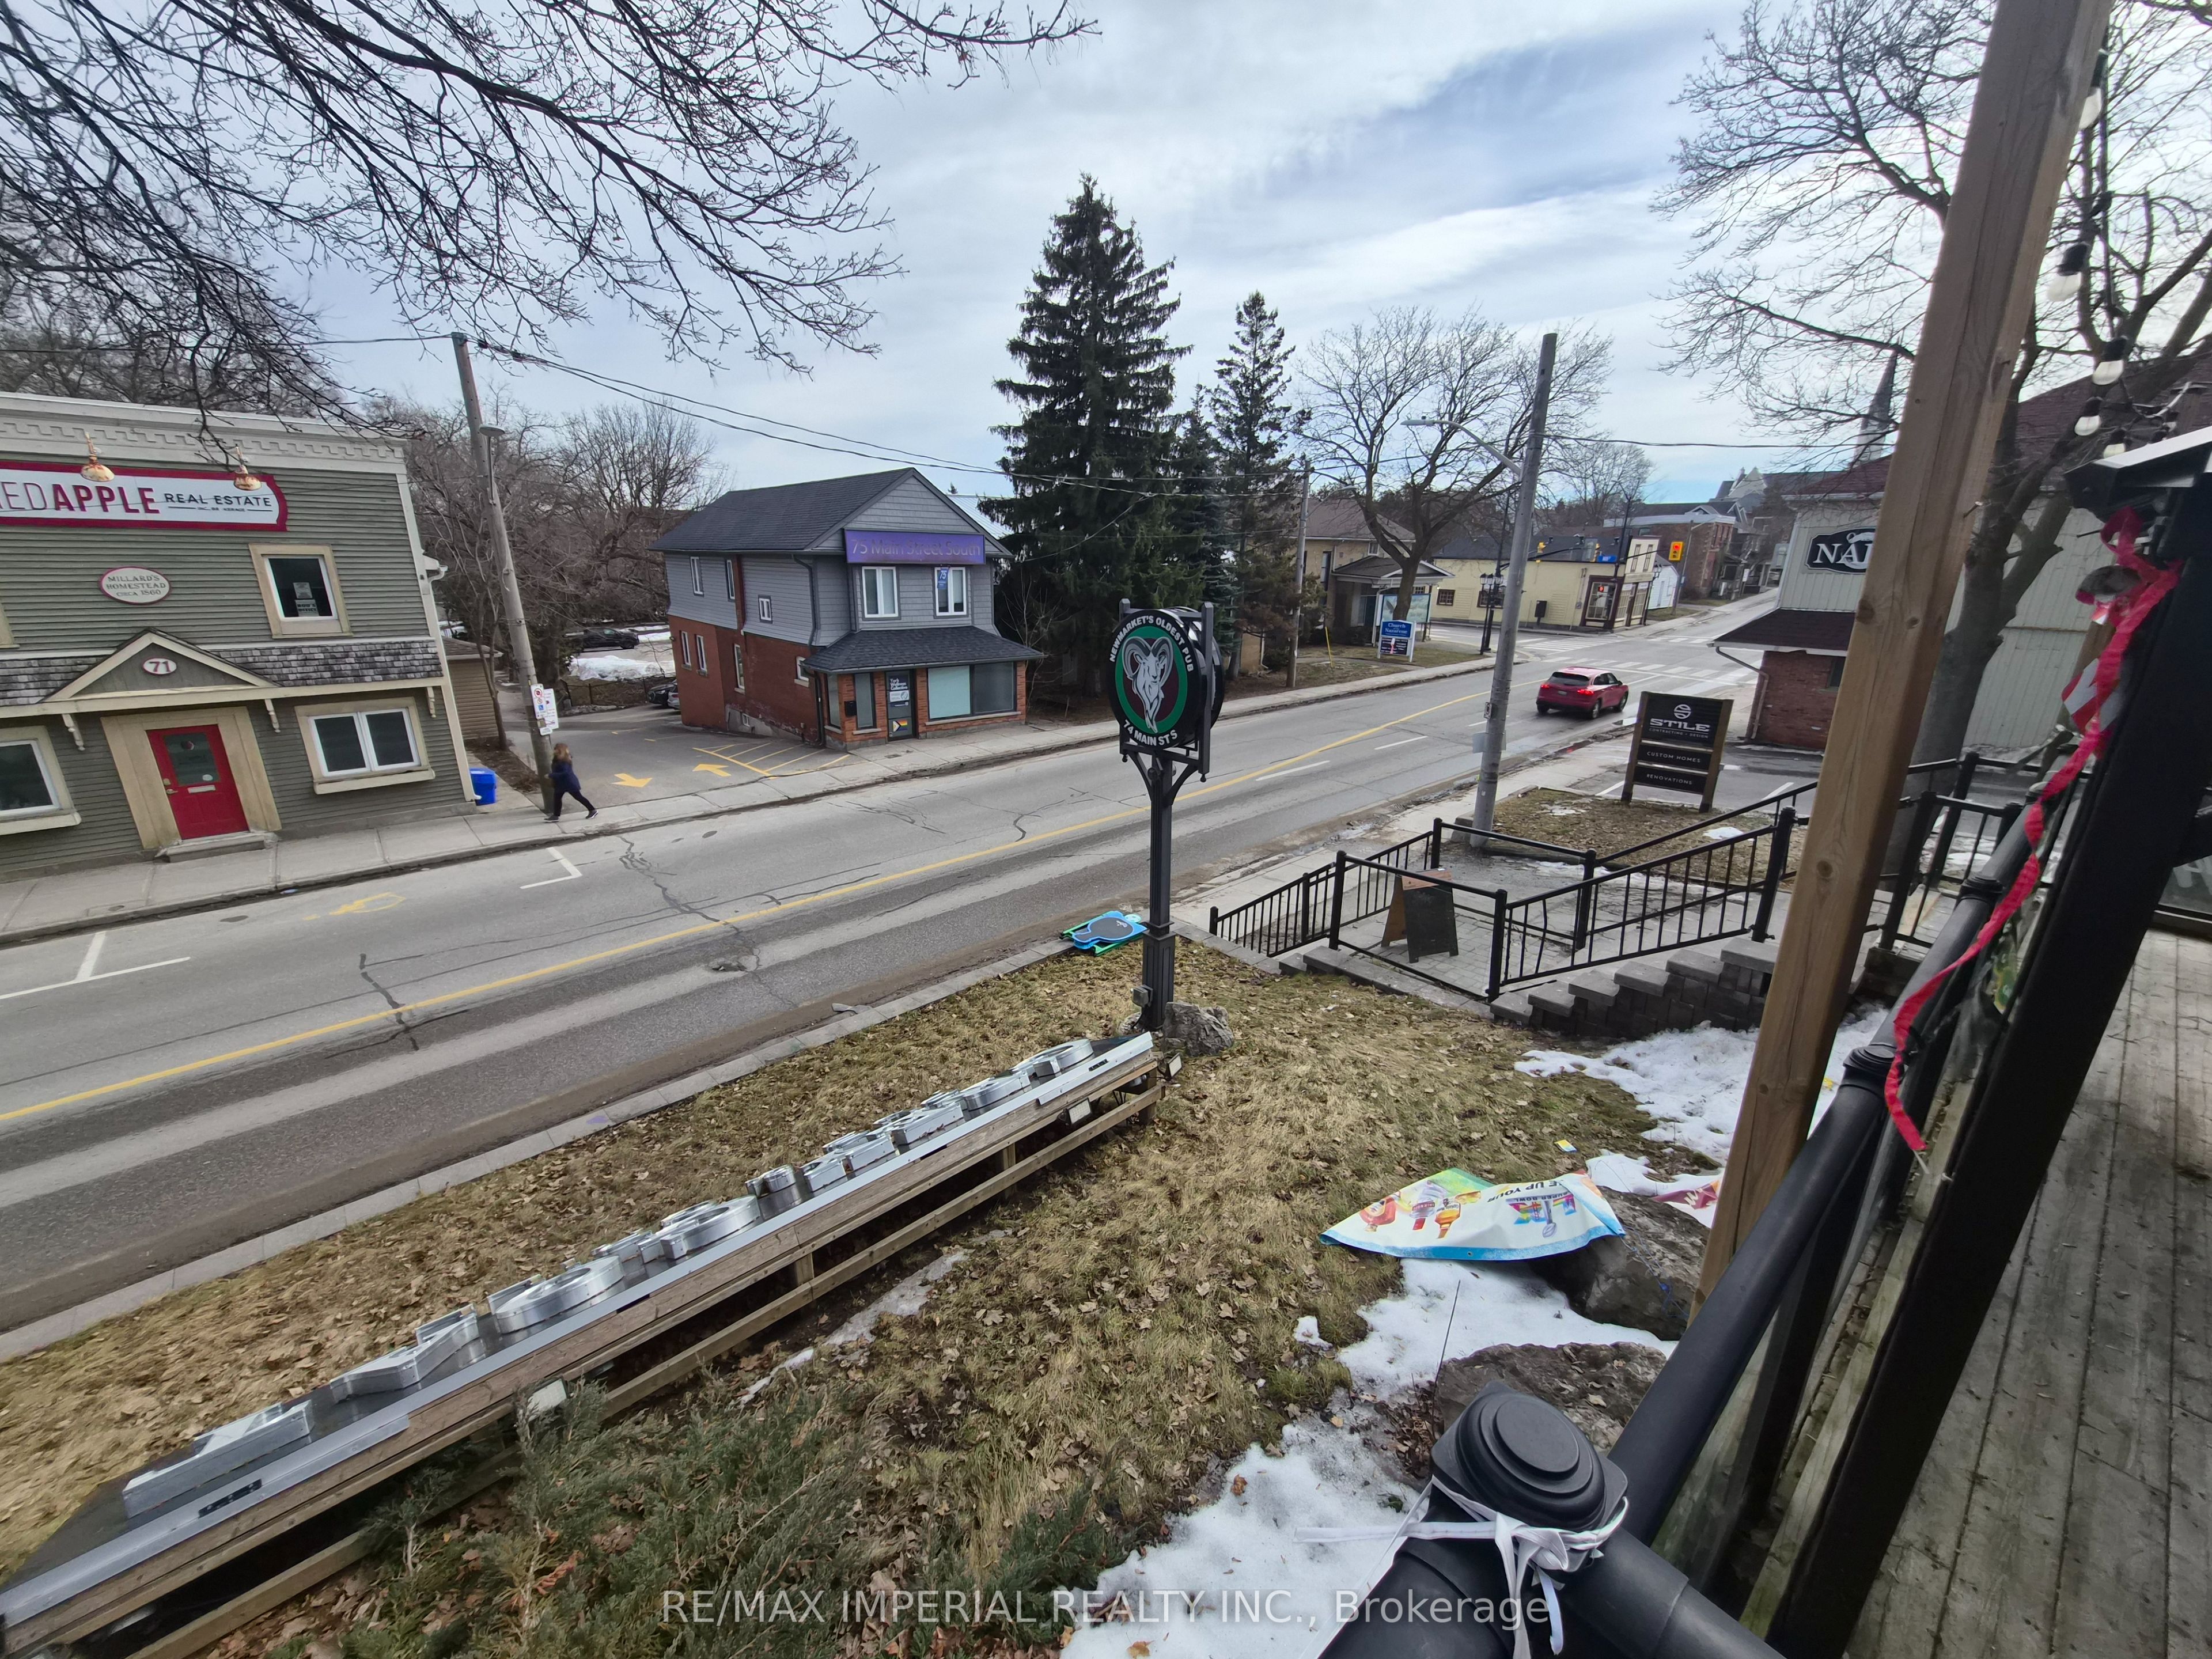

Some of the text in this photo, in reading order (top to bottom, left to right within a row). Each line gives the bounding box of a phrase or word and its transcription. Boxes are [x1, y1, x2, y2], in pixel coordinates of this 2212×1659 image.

[0, 480, 47, 510] ED
[164, 493, 208, 504] REAL
[214, 495, 272, 507] ESTATE
[851, 539, 980, 556] 75 Main Street South
[940, 570, 948, 579] 75
[1109, 615, 1194, 672] NEWMARKET'S OLDEST PUB
[149, 661, 171, 673] 71
[1650, 718, 1710, 732] STILE
[1123, 719, 1134, 735] 74
[1134, 729, 1157, 746] MAIN
[1676, 755, 1700, 763] HOMES
[1646, 774, 1693, 785] RENOVATIONS
[1525, 1181, 1544, 1191] UP
[1487, 1187, 1521, 1203] YOUR
